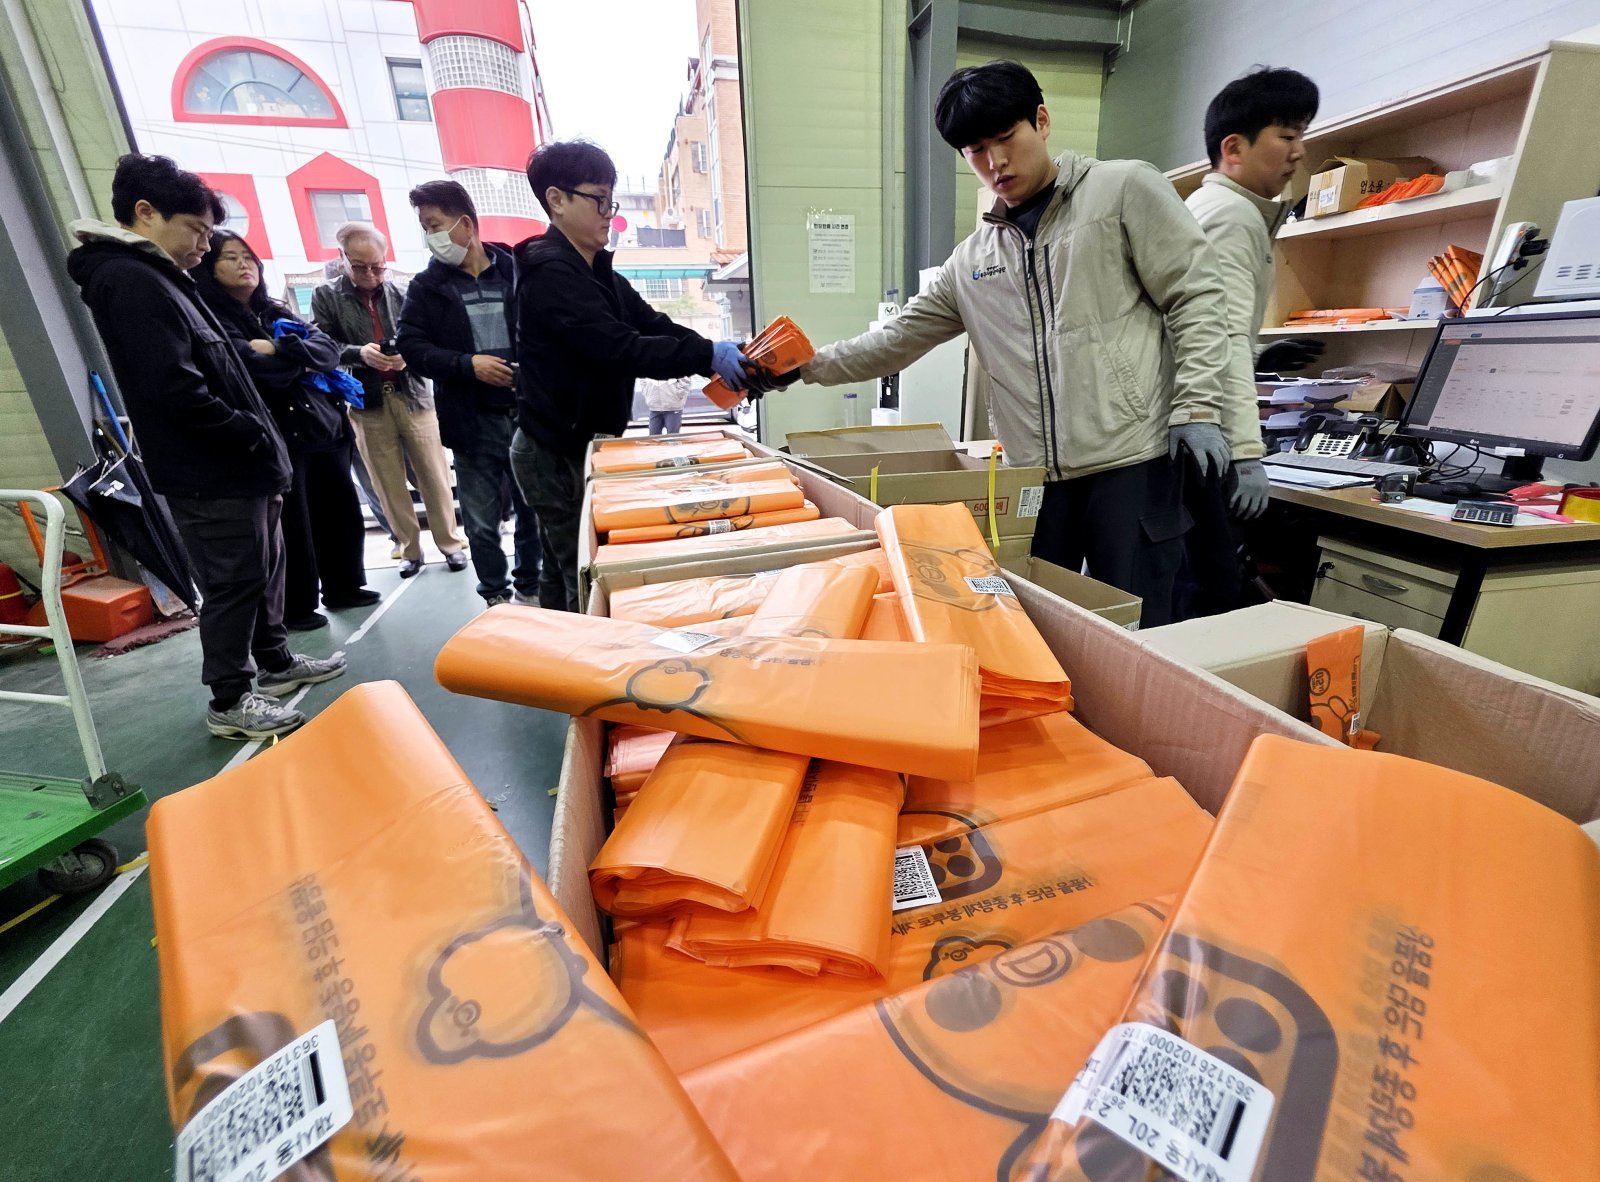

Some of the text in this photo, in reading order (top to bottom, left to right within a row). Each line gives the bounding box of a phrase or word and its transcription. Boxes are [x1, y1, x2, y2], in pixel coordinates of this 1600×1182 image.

[1360, 180, 1384, 195] 업소용
[275, 1111, 335, 1169] 재사용
[1127, 1114, 1161, 1148] 20L
